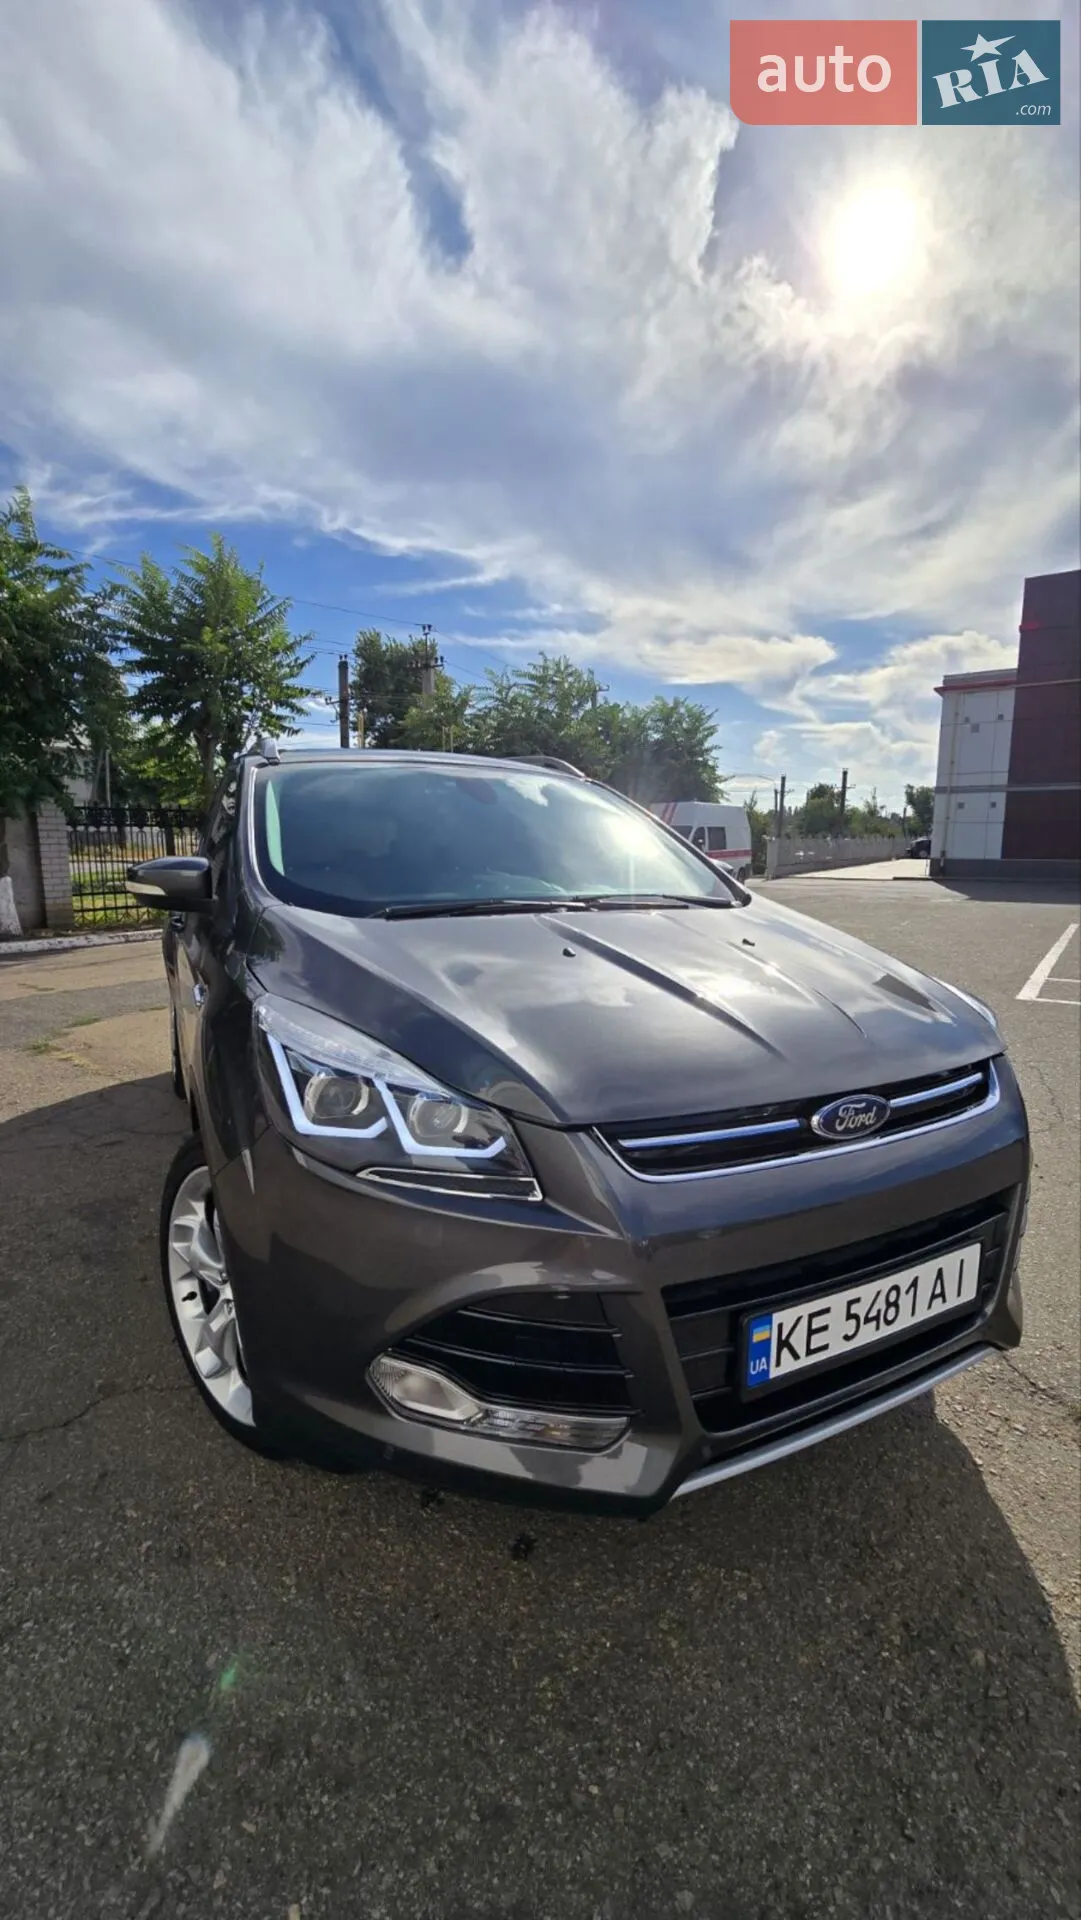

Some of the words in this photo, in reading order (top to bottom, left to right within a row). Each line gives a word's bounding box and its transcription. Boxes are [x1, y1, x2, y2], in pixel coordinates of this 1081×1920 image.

[835, 1102, 877, 1131] Ford
[775, 1307, 831, 1368] KE
[842, 1276, 919, 1342] 5481
[926, 1258, 965, 1311] AI
[750, 1357, 768, 1375] UA
